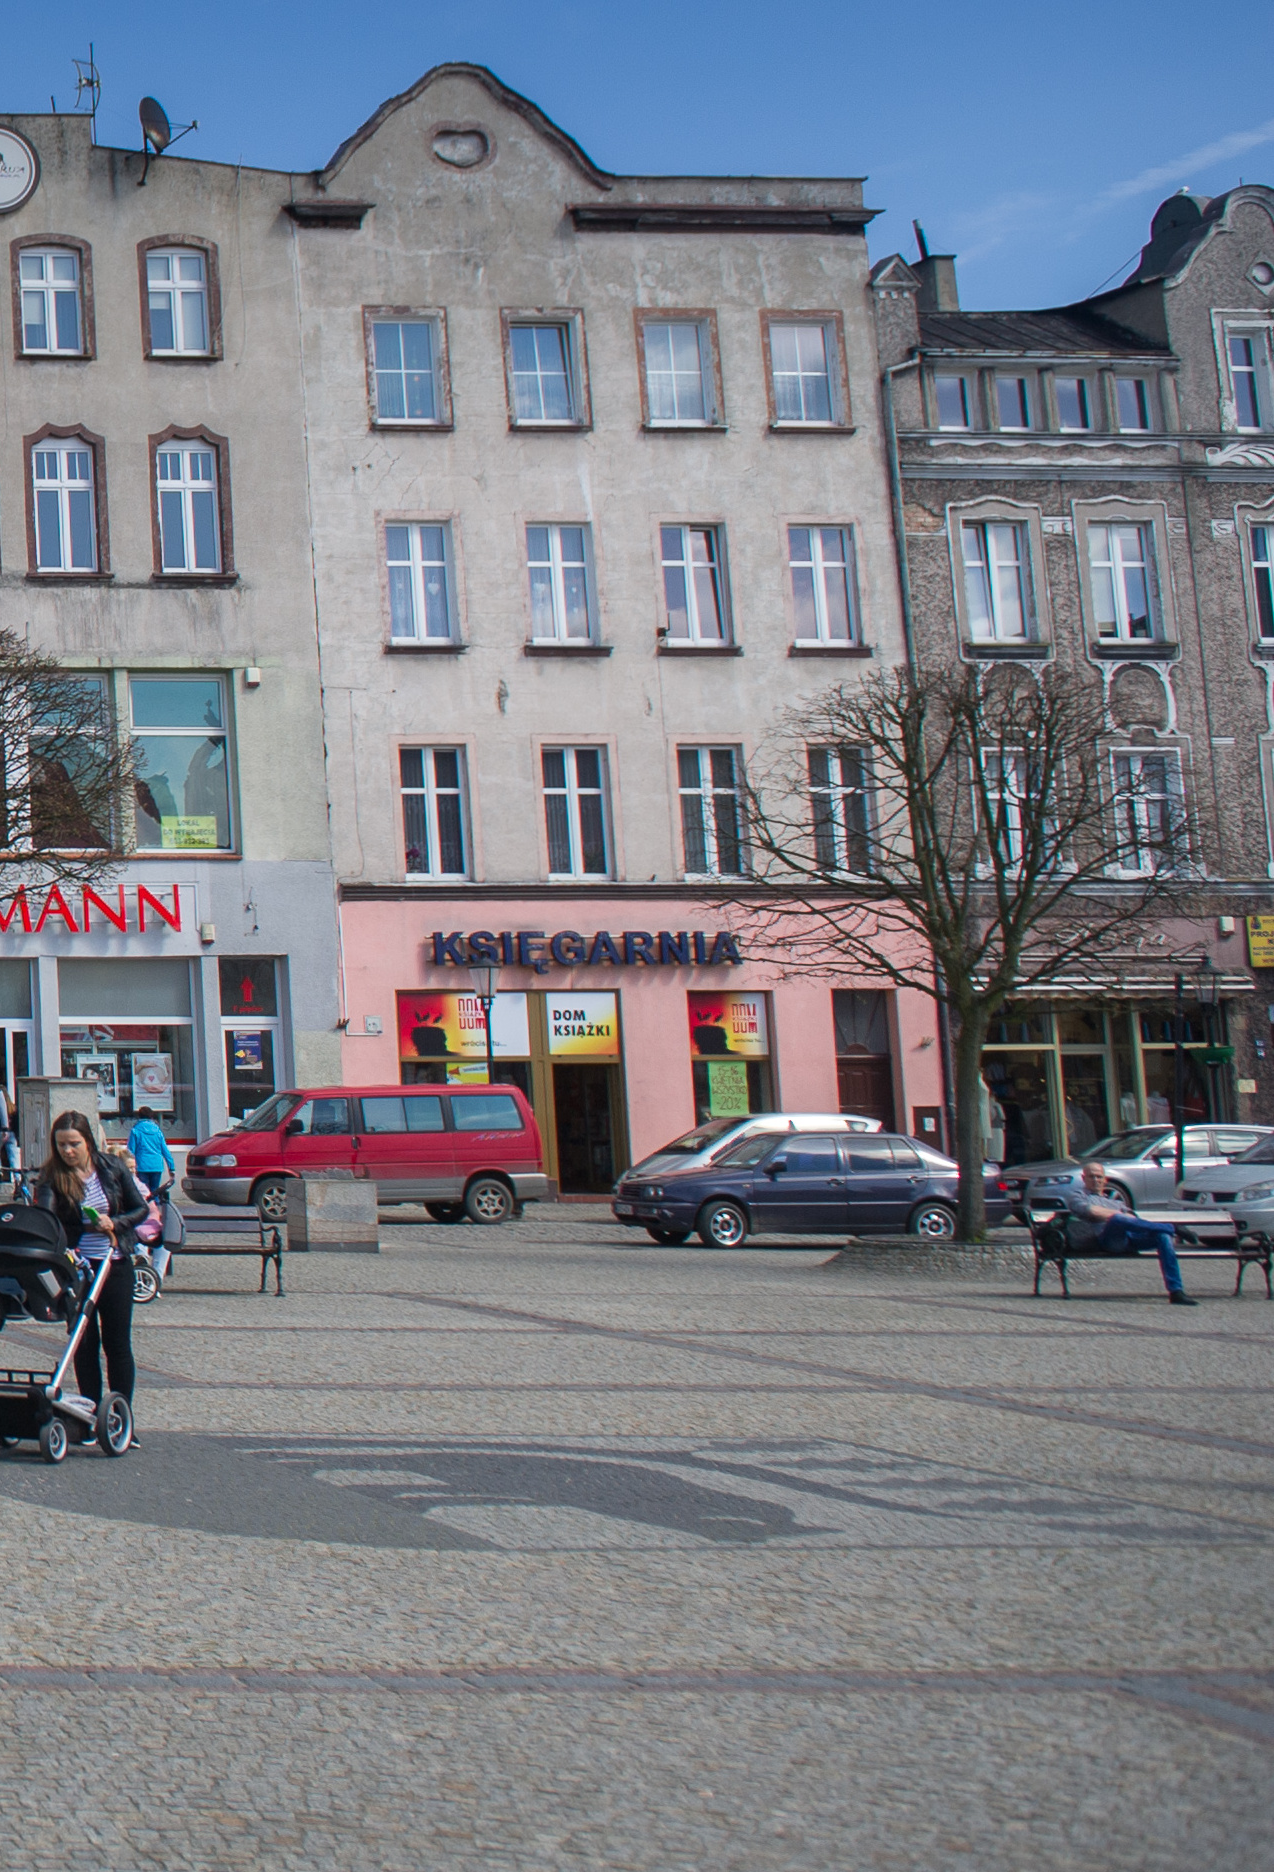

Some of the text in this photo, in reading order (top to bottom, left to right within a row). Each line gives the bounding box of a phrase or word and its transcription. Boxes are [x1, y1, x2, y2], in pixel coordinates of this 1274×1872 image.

[431, 931, 744, 975] KSIĘGARNIA
[553, 1009, 585, 1021] DOM
[554, 1021, 610, 1038] KSIĄŻKI
